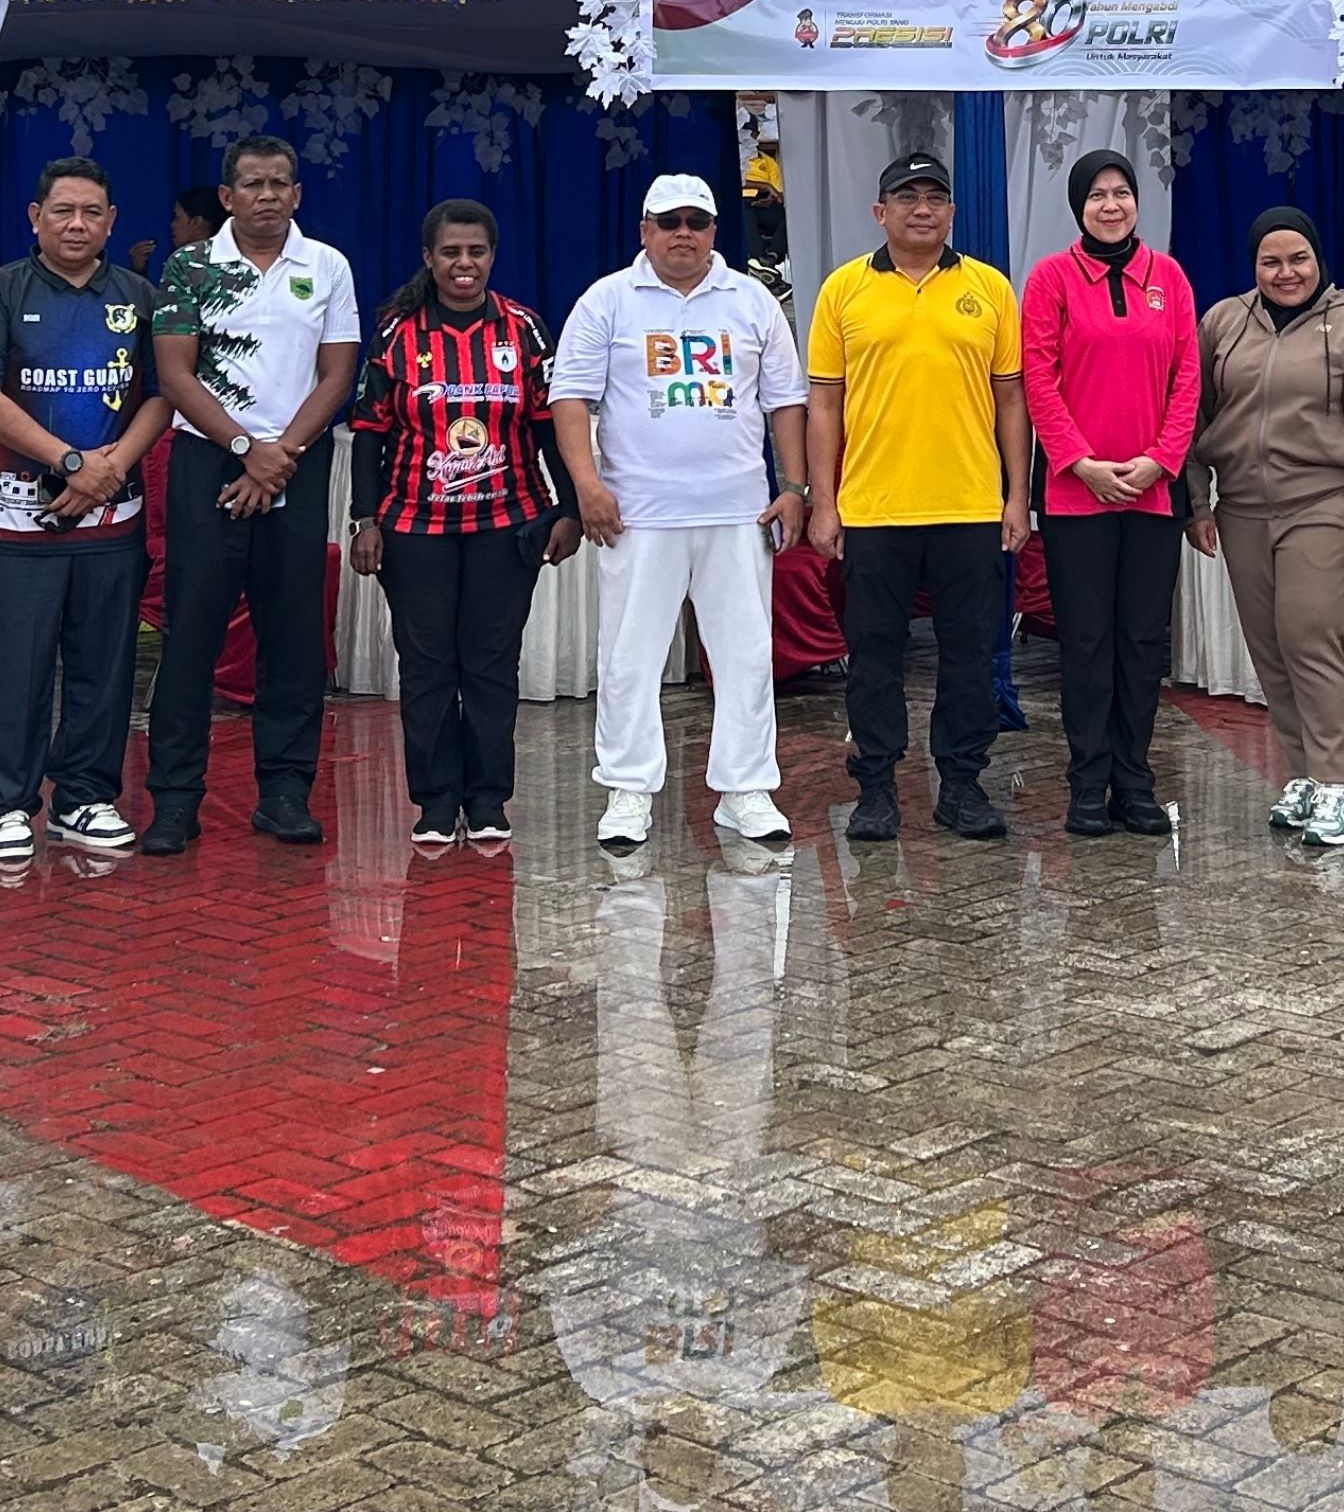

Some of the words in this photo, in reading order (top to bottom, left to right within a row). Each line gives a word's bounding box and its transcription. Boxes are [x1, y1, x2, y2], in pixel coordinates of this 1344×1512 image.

[1085, 1, 1118, 12] Tahun
[1121, 1, 1179, 14] Mengabdi
[832, 26, 954, 42] PRESISI
[1084, 19, 1179, 45] POLRI
[645, 333, 734, 377] BRI
[20, 367, 78, 387] COAST
